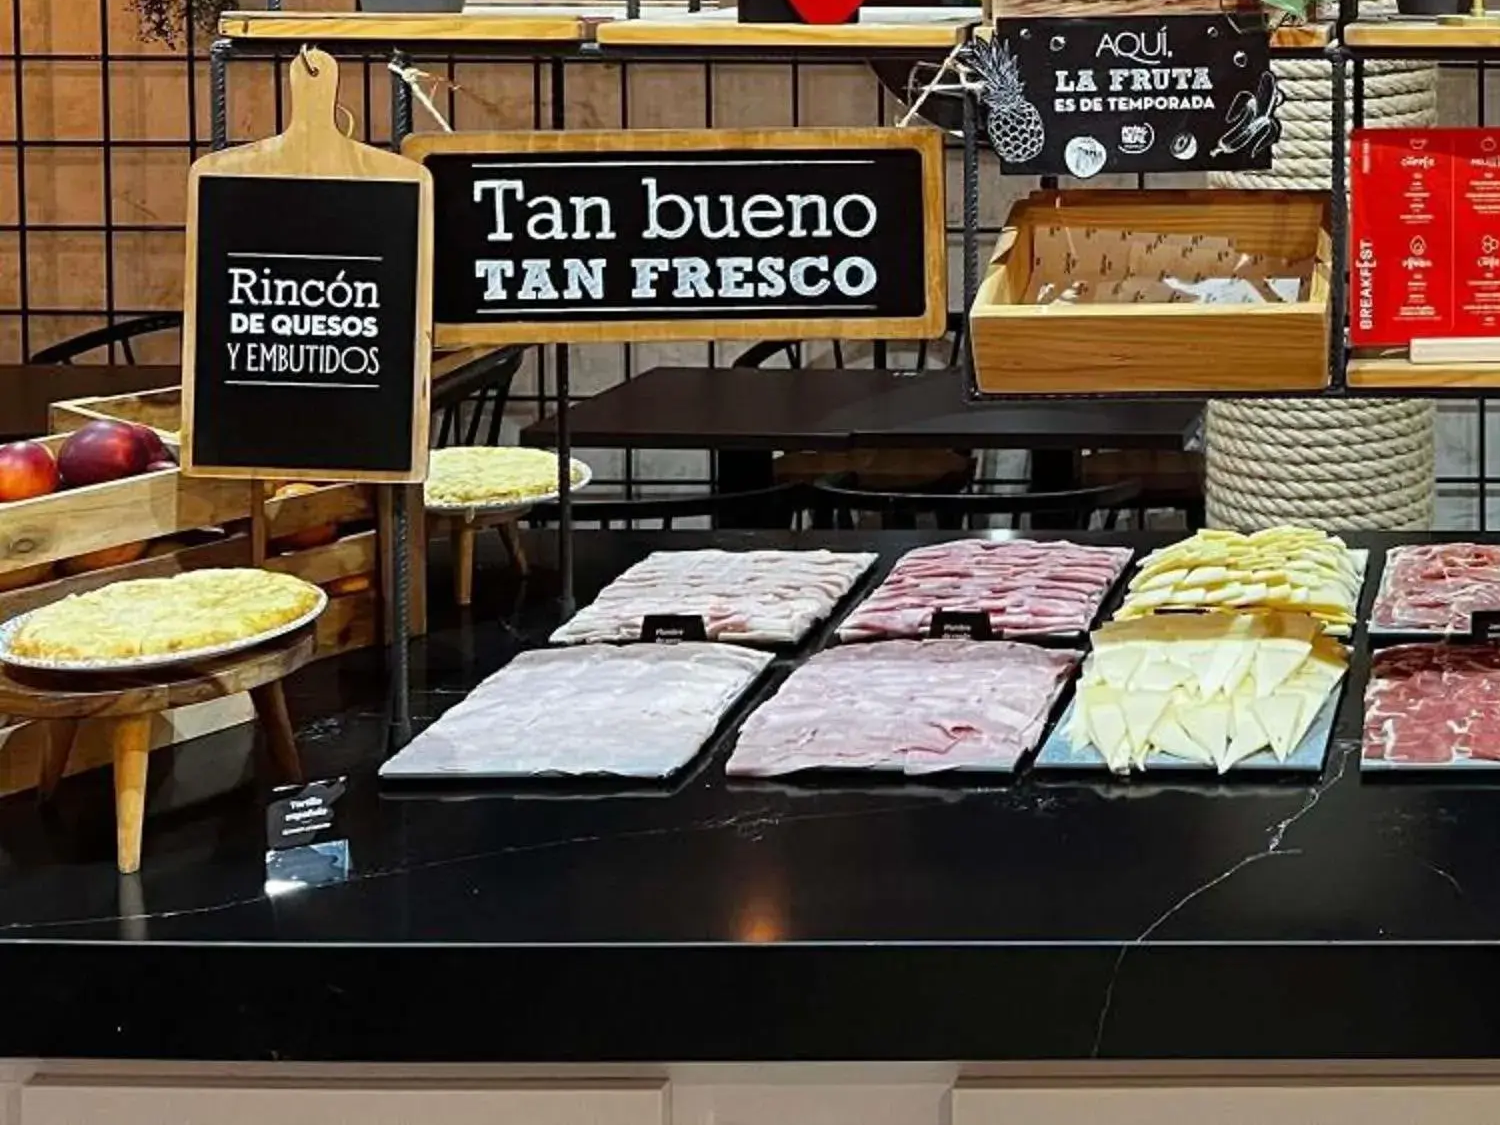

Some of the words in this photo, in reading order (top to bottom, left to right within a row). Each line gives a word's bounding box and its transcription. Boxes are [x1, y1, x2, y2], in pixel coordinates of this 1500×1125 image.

[1055, 70, 1098, 93] LA
[1109, 66, 1214, 92] FRUTA
[1054, 98, 1076, 112] ES
[1080, 97, 1103, 112] DE
[1107, 95, 1216, 112] TEMPORADA
[472, 178, 617, 242] Tan
[641, 177, 878, 241] bueno
[227, 266, 381, 308] Rincón
[475, 258, 607, 301] TAN
[630, 255, 878, 300] FRESCO
[230, 312, 265, 334] DE
[271, 314, 379, 338] QUESOS
[226, 342, 241, 371] Y
[246, 342, 381, 376] EMBUTIDOS
